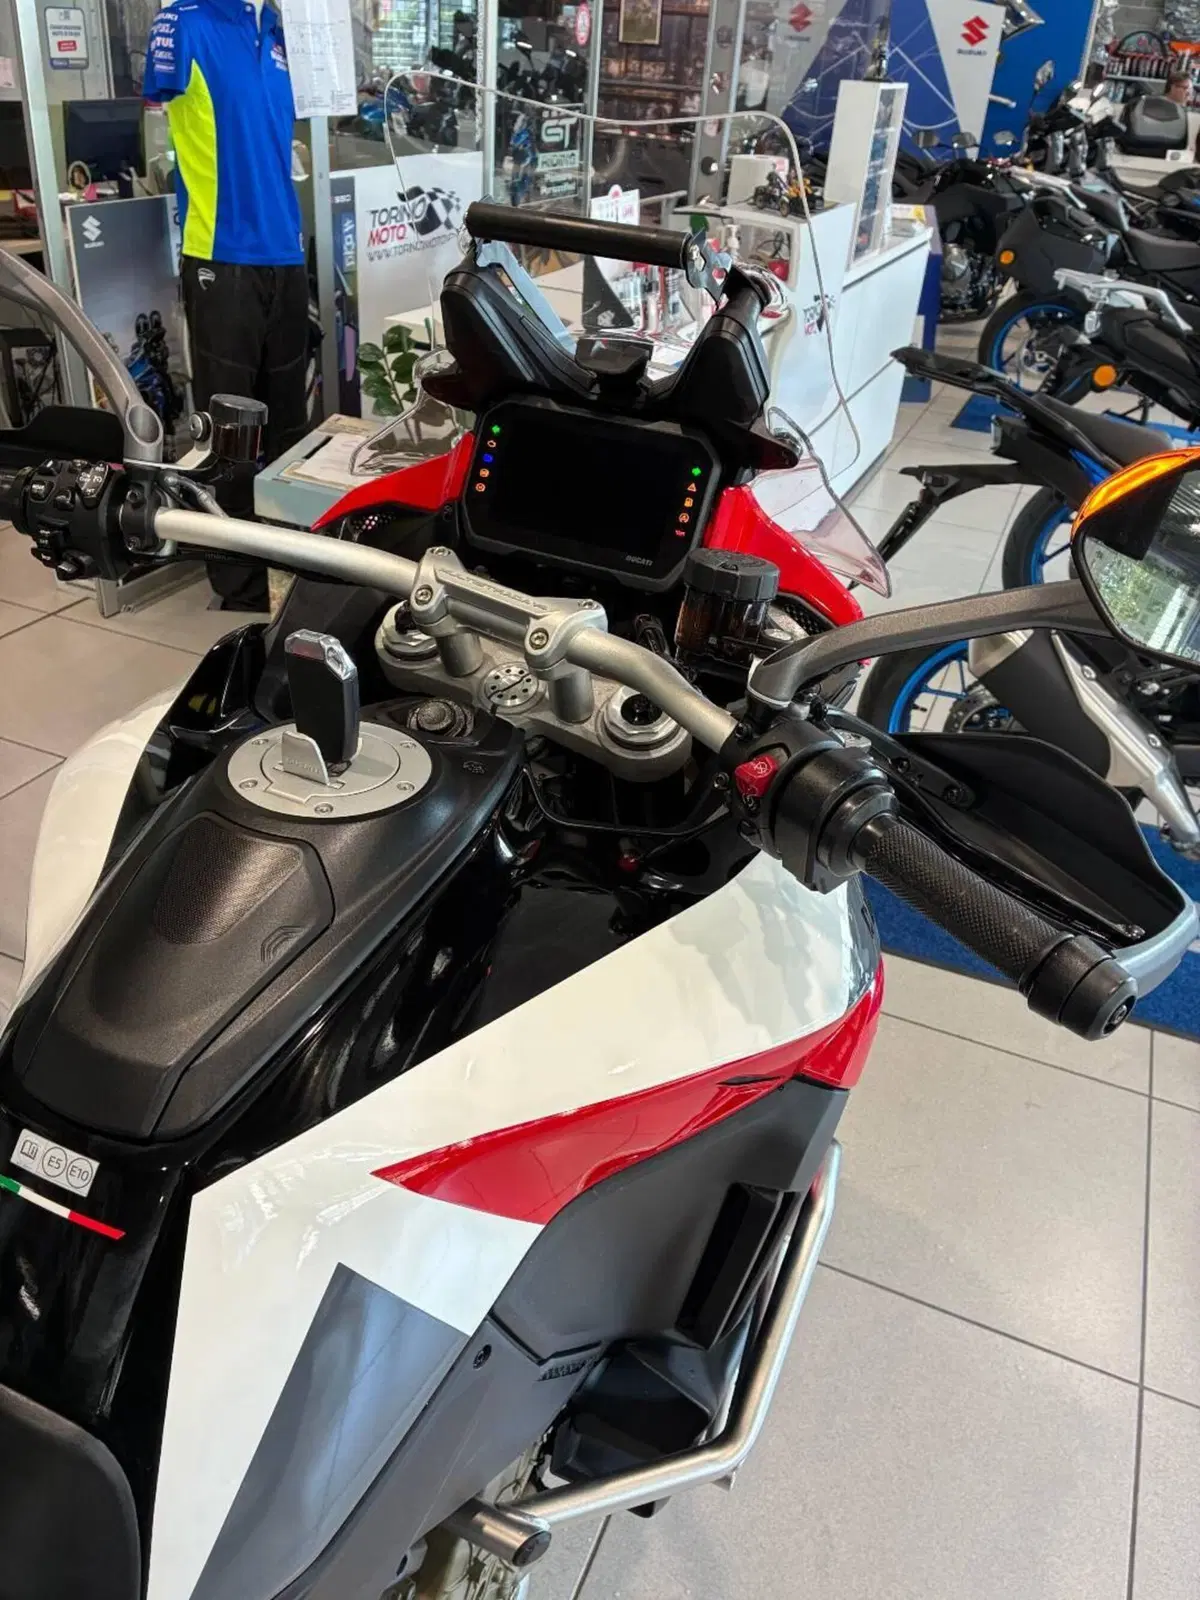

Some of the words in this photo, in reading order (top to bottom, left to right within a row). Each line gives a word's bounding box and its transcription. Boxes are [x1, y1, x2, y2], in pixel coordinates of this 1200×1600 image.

[367, 197, 427, 228] TORINO
[367, 224, 407, 247] MOTO
[625, 555, 653, 567] DUCATI
[47, 1155, 63, 1170] E5
[69, 1165, 90, 1182] E10
